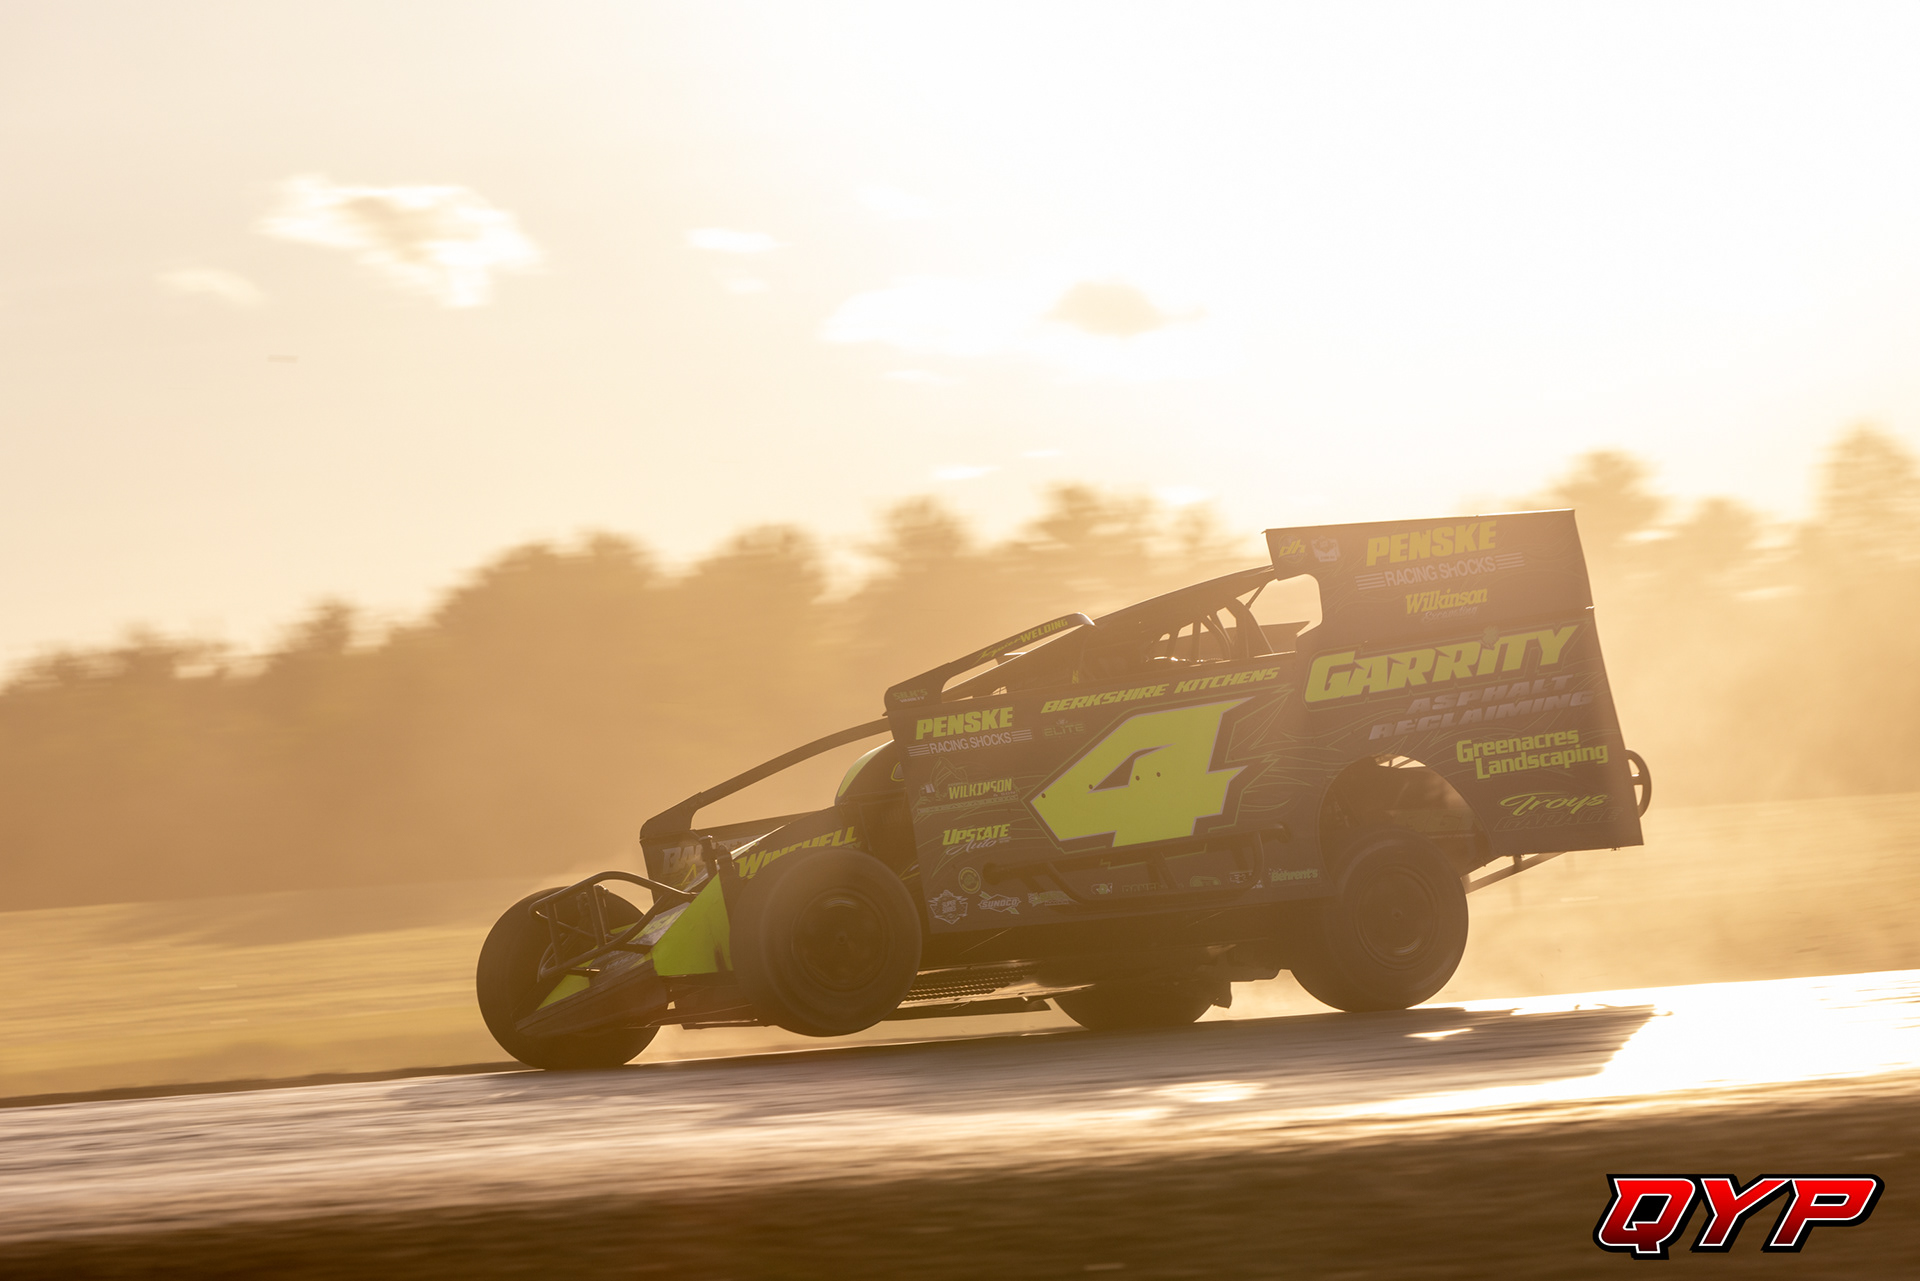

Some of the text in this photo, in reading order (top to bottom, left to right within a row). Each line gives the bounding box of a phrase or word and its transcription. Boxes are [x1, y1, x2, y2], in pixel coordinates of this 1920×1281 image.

[1365, 520, 1497, 567] PENSKE
[1384, 554, 1497, 587] RACING SHOCKS
[1405, 588, 1488, 615] Wilkinson
[1020, 618, 1068, 643] WELDING
[1040, 666, 1280, 714] BERKSHIRE KITCHENS
[1406, 674, 1576, 715] ASPHALT
[915, 706, 1014, 741] PENSKE
[1043, 722, 1085, 738] ELITE
[1367, 690, 1596, 740] RECLAIMING
[929, 732, 1012, 753] RACING SHOCKS
[1456, 730, 1580, 763] Greenacres
[1030, 696, 1256, 848] 4
[1474, 745, 1609, 780] Landscaping
[948, 778, 1013, 800] WILKINSON
[942, 823, 1011, 846] UPSTATE
[945, 837, 997, 856] Auto
[981, 897, 1019, 909] SUNOCO
